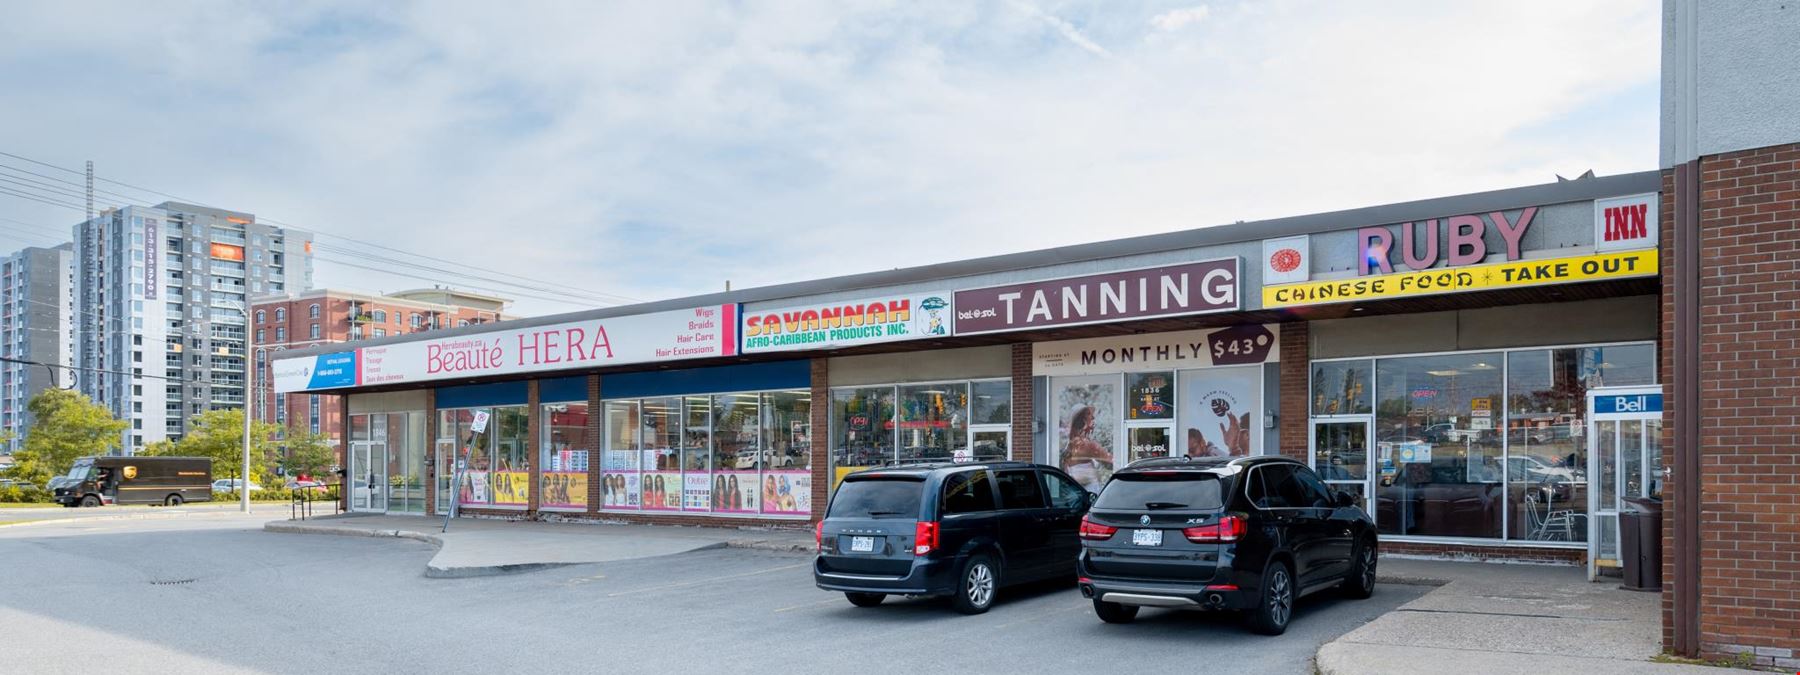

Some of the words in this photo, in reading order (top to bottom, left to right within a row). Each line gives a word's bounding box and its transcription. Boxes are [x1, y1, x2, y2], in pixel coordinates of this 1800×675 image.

[1604, 204, 1648, 242] INN
[1357, 206, 1540, 277] RUBY
[1276, 280, 1385, 302] CHINESE
[1400, 272, 1473, 290] FOOD
[1502, 263, 1569, 282] TAKE
[1582, 256, 1640, 274] OUT
[998, 268, 1234, 324] TANNING
[688, 320, 714, 330] Braids
[695, 308, 714, 318] Wigs
[746, 298, 911, 336] SAVANNAH
[518, 324, 614, 366] HERA
[656, 348, 672, 357] Hair
[673, 346, 714, 356] Extensions
[676, 334, 694, 344] Hair
[695, 332, 714, 342] Care
[746, 330, 826, 348] AFRO-CARIBBEAN
[830, 325, 882, 341] PRODUCTS
[887, 323, 910, 336] INC.
[426, 338, 503, 374] Beauté
[1081, 342, 1202, 366] MONTHLY
[1214, 338, 1254, 359] $43
[1615, 396, 1646, 412] Bell
